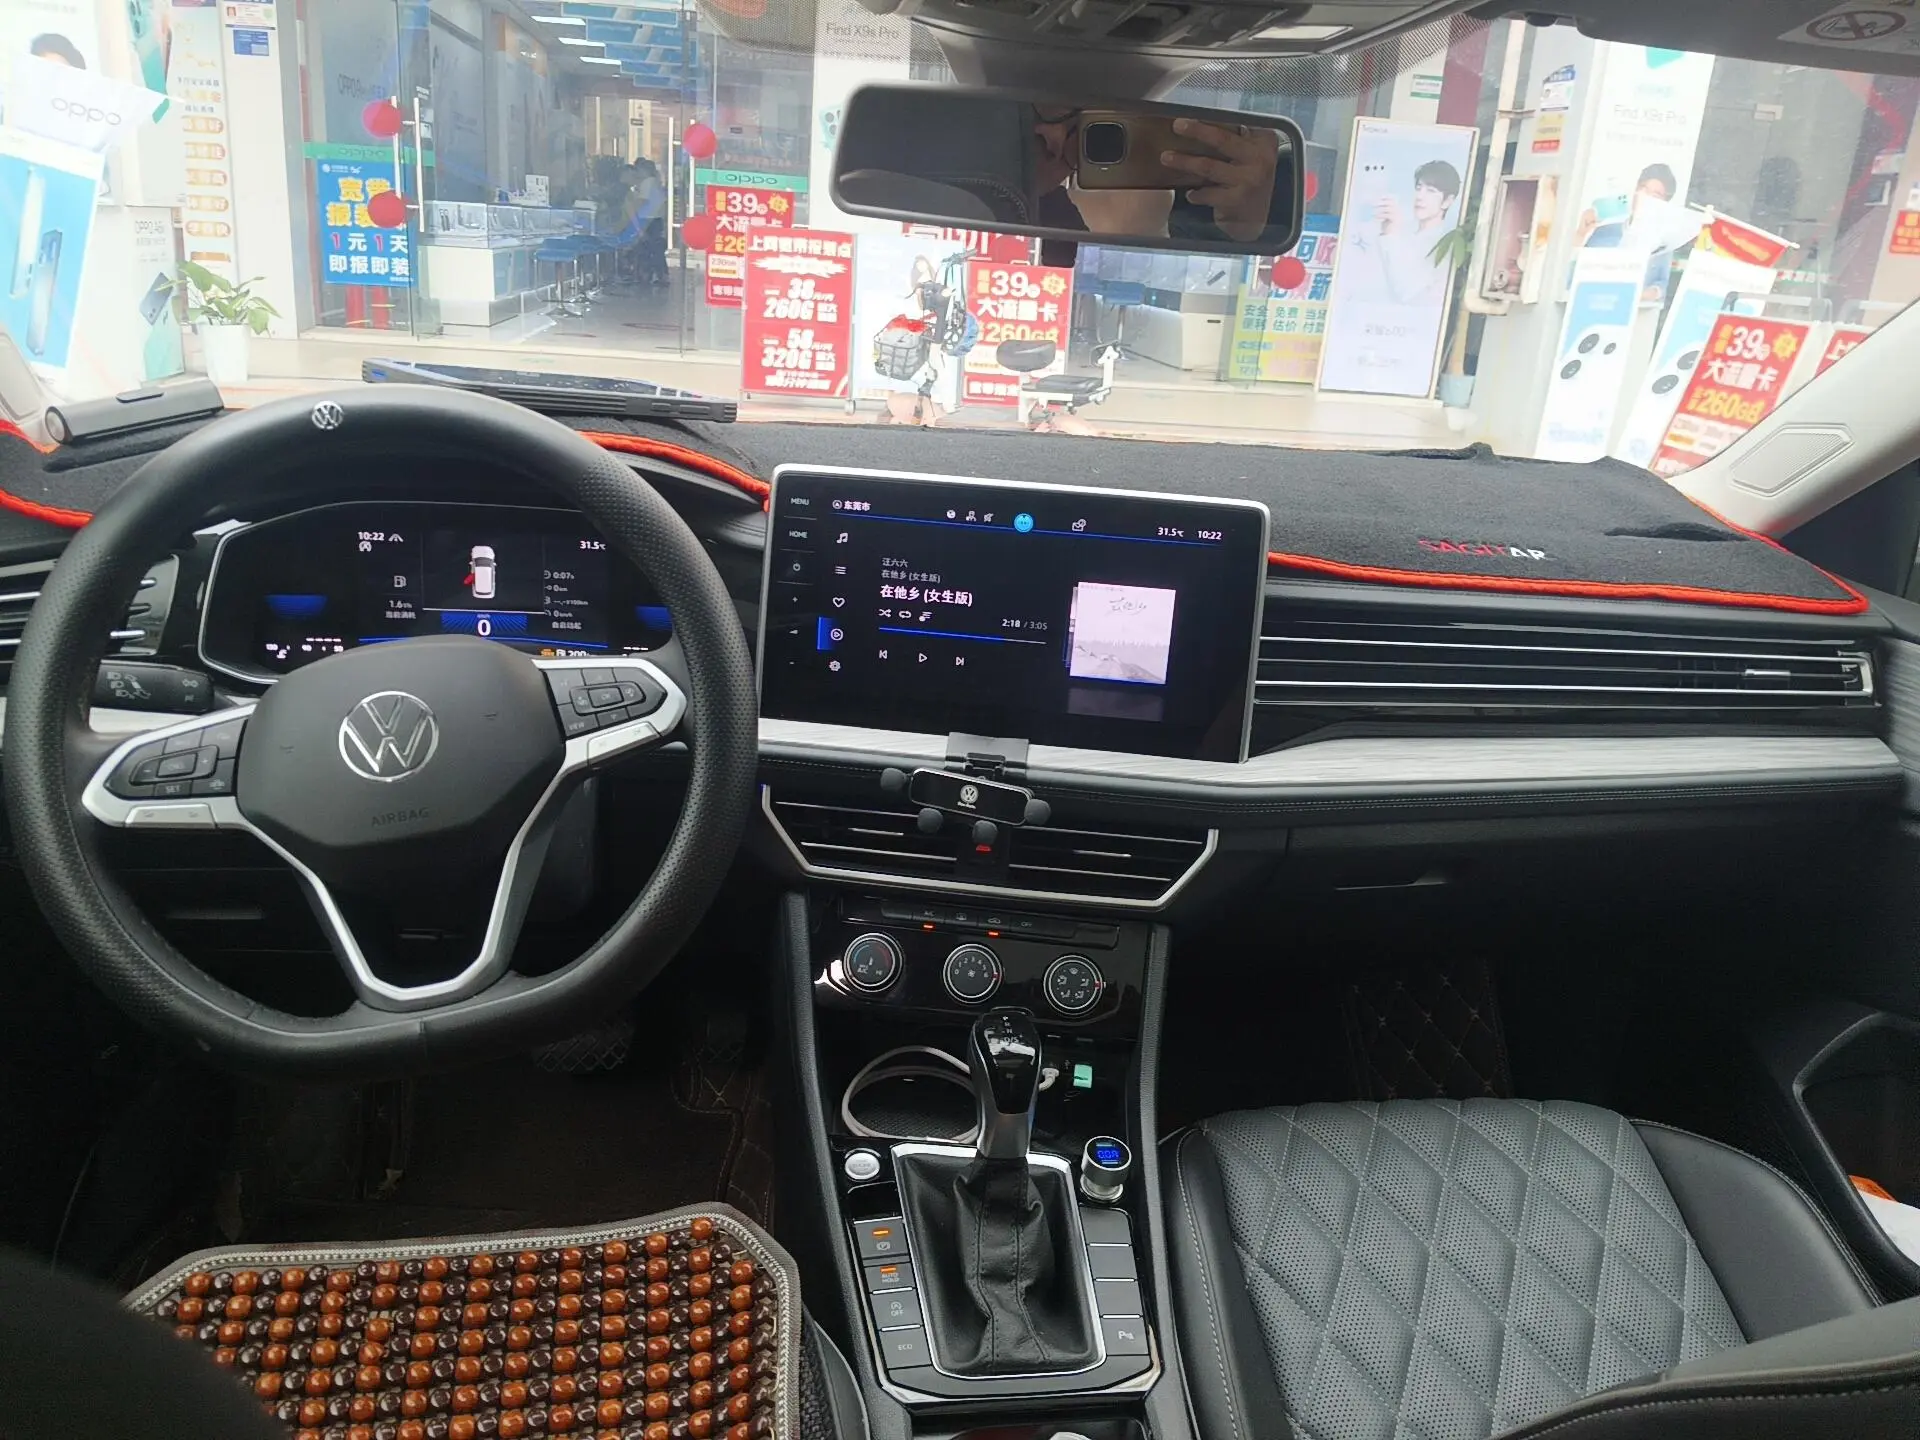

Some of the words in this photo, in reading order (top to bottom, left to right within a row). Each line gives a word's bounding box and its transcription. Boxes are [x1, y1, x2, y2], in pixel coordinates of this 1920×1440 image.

[51, 97, 121, 125] oppo
[727, 192, 758, 214] 39
[329, 255, 410, 276] 即报即装
[991, 270, 1029, 297] 39
[1725, 325, 1766, 360] 39
[790, 498, 810, 506] MENU
[844, 500, 871, 512] 东莞市
[358, 531, 385, 541] 10:22
[789, 531, 808, 539] HOME
[1197, 530, 1222, 540] 10:22
[882, 557, 908, 568] 汪六六
[881, 569, 907, 580] 在他乡
[879, 584, 920, 602] 在他乡
[923, 588, 973, 607] (女生版)
[477, 619, 491, 636] 0
[1002, 618, 1021, 628] 2:18
[1029, 621, 1048, 630] 3:05
[370, 806, 430, 828] AIRBAG
[891, 1309, 905, 1317] OFF
[897, 1343, 913, 1351] ECO
